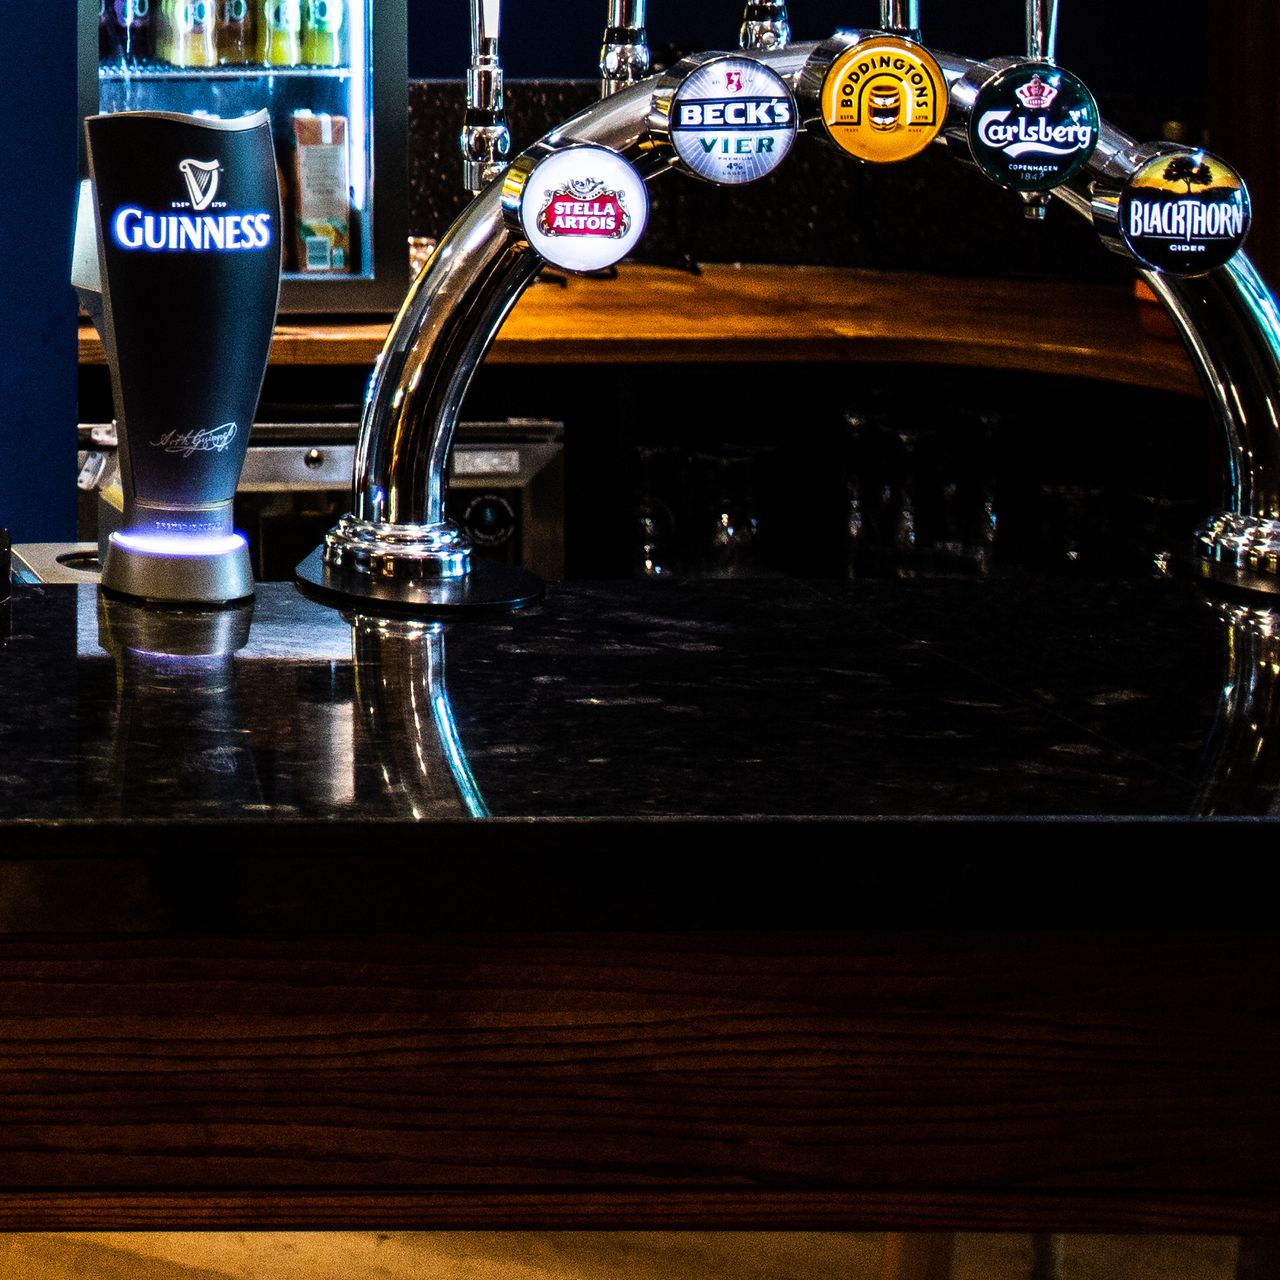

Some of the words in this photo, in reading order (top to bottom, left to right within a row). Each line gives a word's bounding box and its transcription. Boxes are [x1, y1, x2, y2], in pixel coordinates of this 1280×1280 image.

[840, 55, 929, 109] BODDINGTONS
[680, 98, 791, 125] BECK'S
[977, 110, 1093, 154] Carlsberg
[698, 135, 775, 154] VIER
[726, 162, 744, 170] 4%
[1008, 163, 1059, 172] COPENHAGEN
[554, 201, 616, 216] STELLA
[116, 208, 271, 249] GUINNESS
[552, 216, 616, 230] ARTOIS
[1129, 200, 1244, 242] BLACKTHORN
[1169, 244, 1206, 252] CIDER
